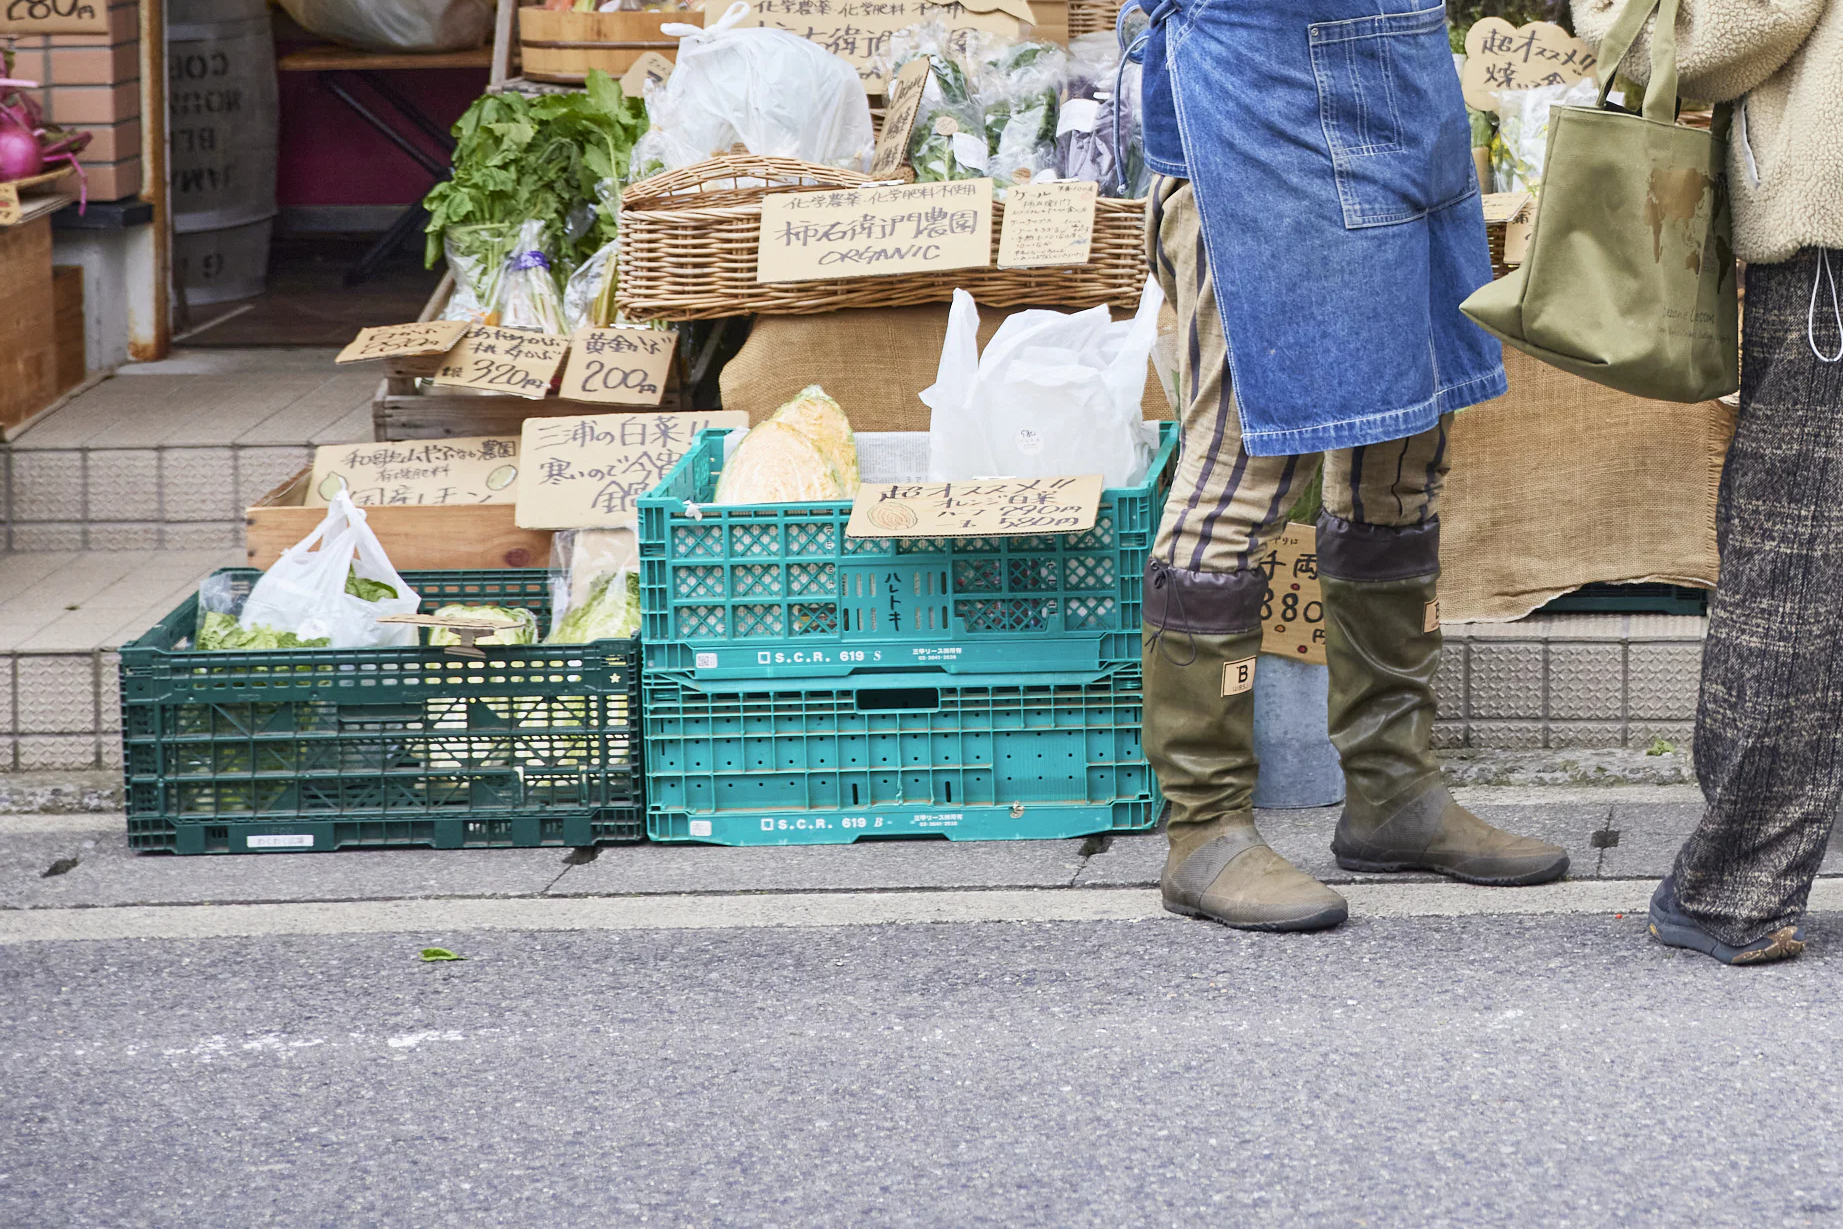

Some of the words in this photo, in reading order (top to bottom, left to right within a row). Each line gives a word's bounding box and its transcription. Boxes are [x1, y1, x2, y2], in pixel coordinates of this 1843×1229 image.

[818, 244, 941, 266] ORGANIC
[582, 333, 672, 356] 黄金かぶ
[468, 359, 545, 389] 320円
[581, 360, 657, 395] 200円
[534, 415, 710, 451] 三浦の白菜!!
[879, 478, 1077, 502] 超オススメ!!
[933, 490, 1060, 509] オレンジ白菜
[998, 516, 1080, 530] 580円
[1259, 549, 1318, 581] 千両
[885, 572, 902, 632] ハレトキ
[775, 650, 830, 663] S.C.R.
[839, 650, 865, 662] 619
[1237, 664, 1248, 684] B
[778, 819, 833, 831] S.C.R.
[841, 817, 867, 830] 619
